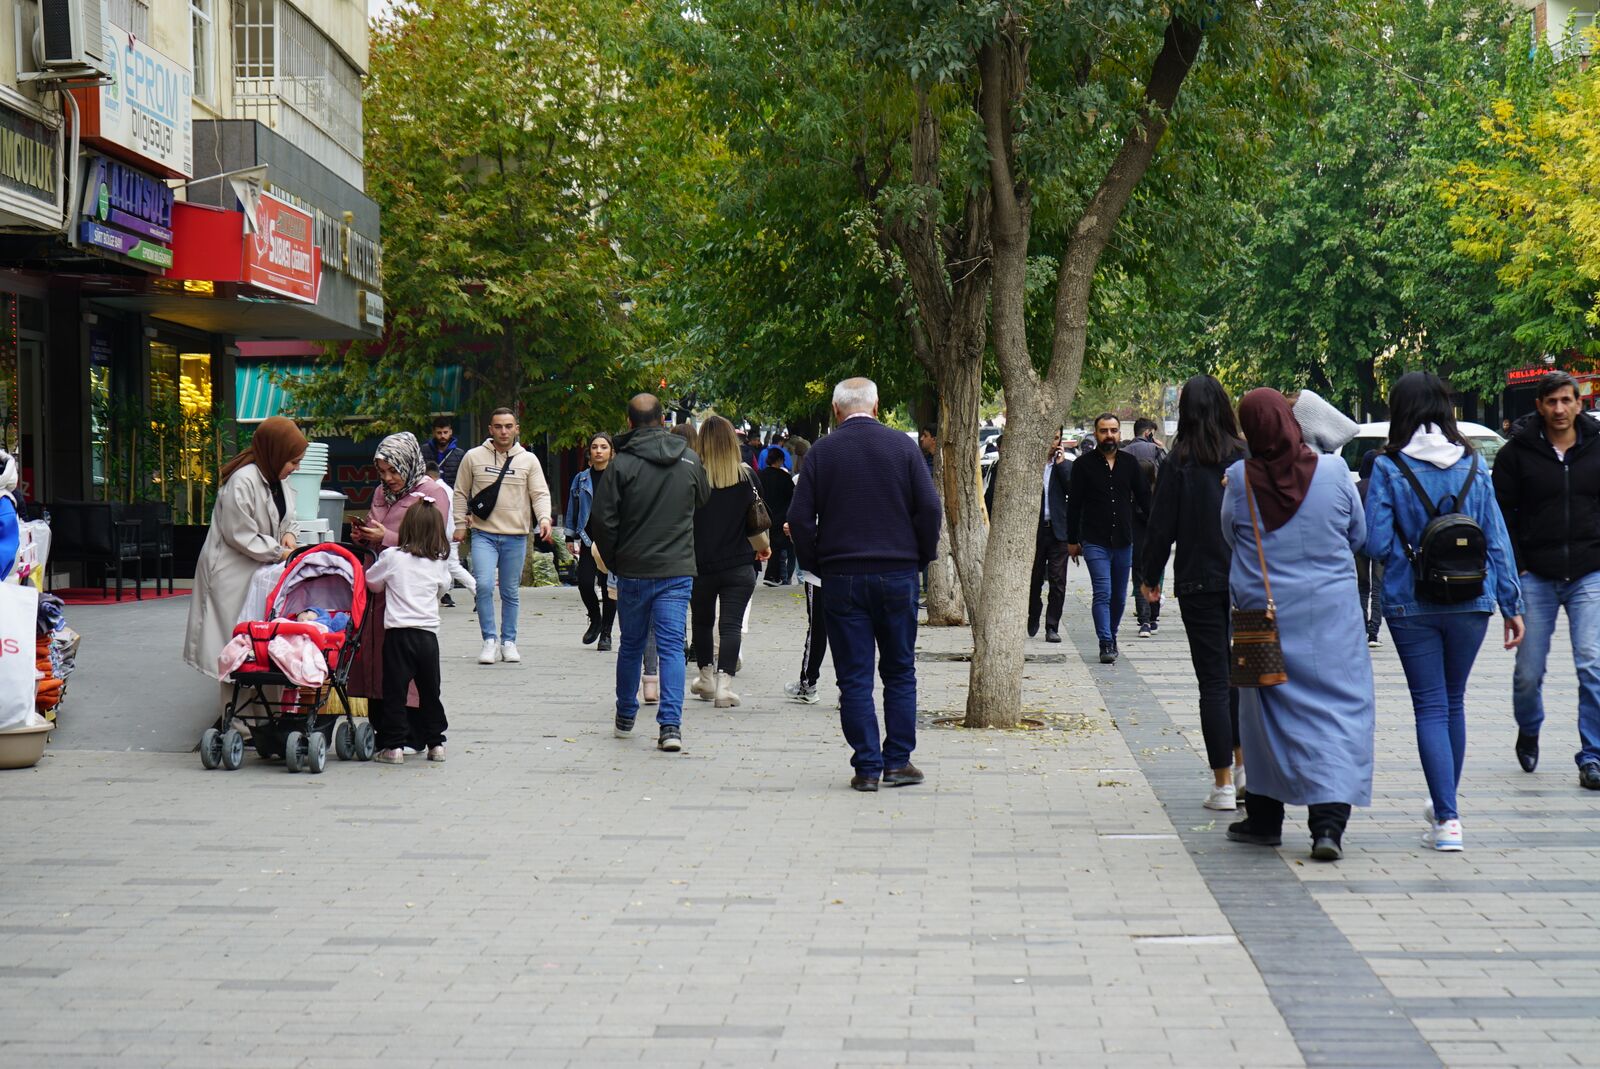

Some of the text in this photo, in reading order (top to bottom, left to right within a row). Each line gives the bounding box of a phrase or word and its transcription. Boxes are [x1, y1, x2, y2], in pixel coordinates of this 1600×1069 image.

[125, 44, 178, 121] EPROM
[0, 126, 55, 193] MCULUK
[132, 103, 174, 159] bilgisayar
[112, 164, 174, 228] AKINSOFT
